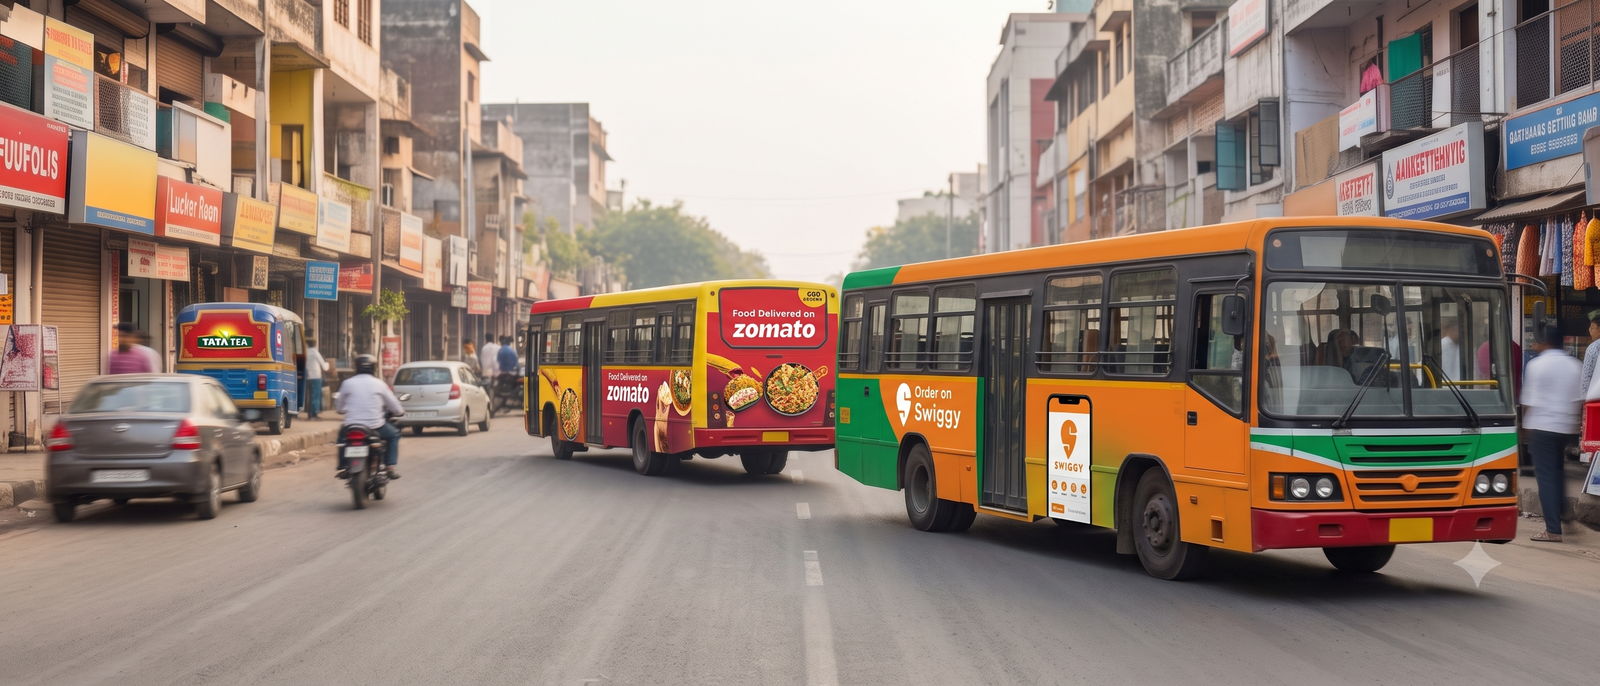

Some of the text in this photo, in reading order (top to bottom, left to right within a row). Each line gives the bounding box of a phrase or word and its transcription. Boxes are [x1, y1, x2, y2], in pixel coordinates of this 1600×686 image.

[732, 309, 756, 318] Food
[758, 309, 802, 318] Delivered
[732, 320, 816, 338] zomato
[202, 338, 248, 346] TATA TEA
[608, 372, 619, 381] Food
[620, 373, 641, 382] Delivered
[606, 383, 650, 404] zomato
[914, 385, 952, 399] Order on
[914, 402, 961, 429] Swiggy
[1054, 461, 1084, 473] SWIGGY
